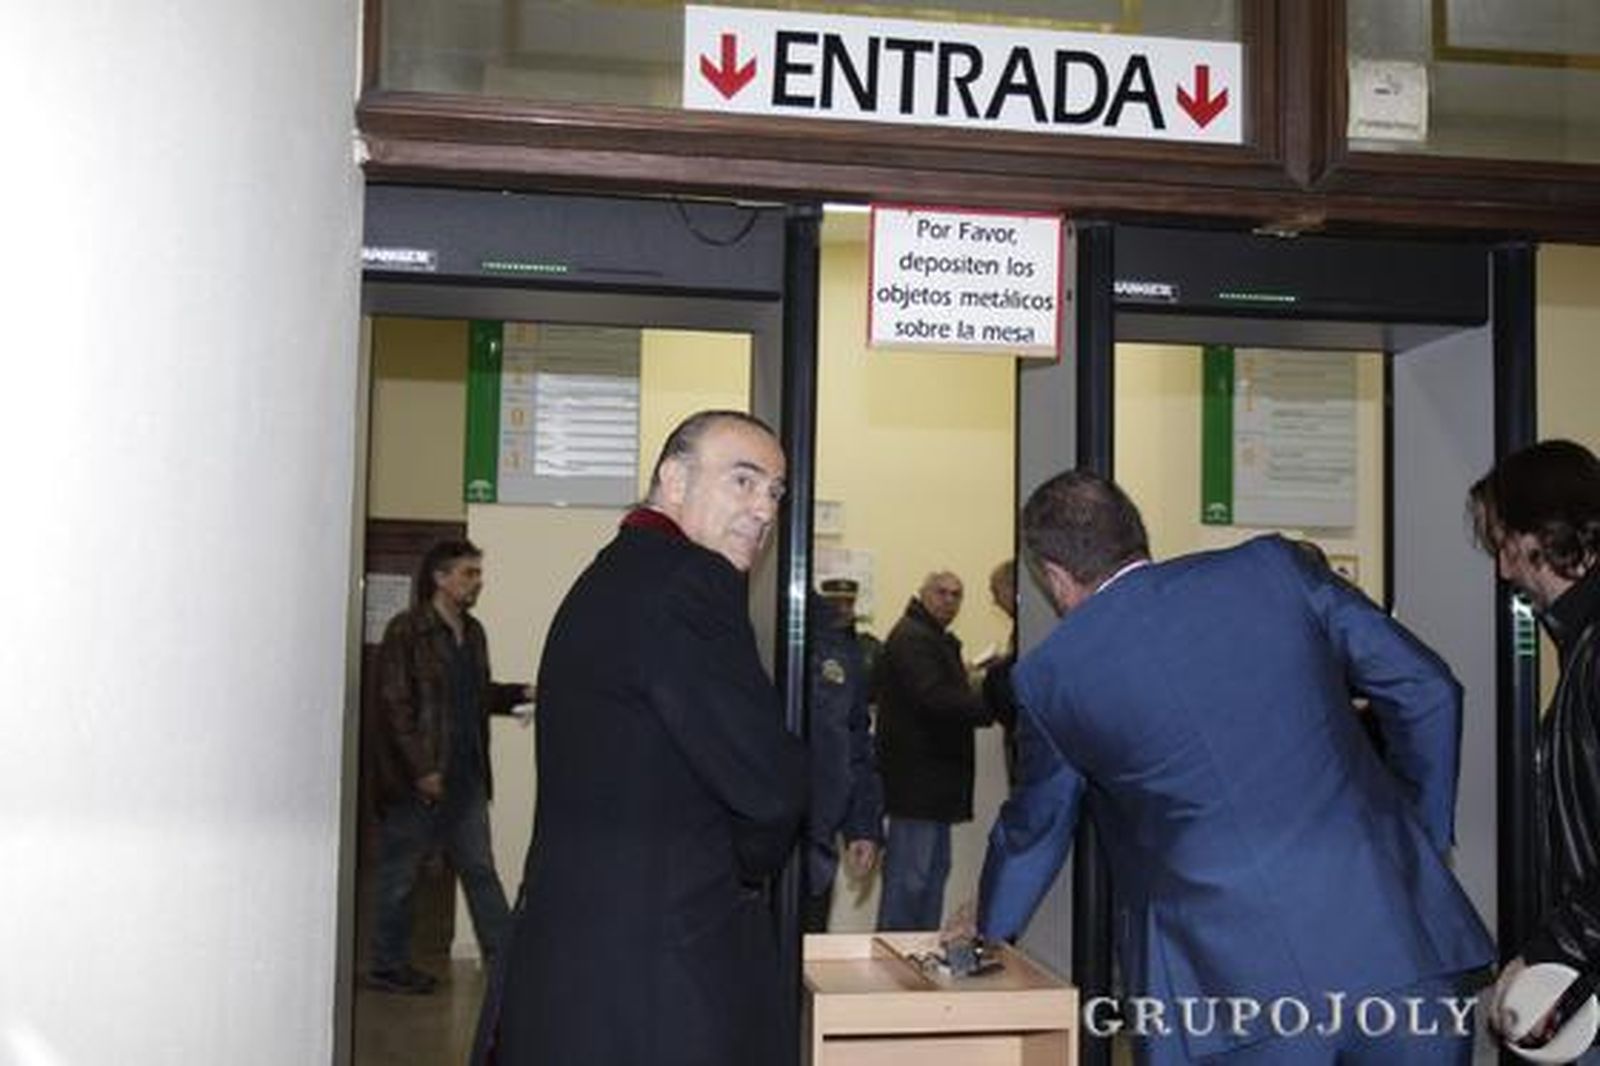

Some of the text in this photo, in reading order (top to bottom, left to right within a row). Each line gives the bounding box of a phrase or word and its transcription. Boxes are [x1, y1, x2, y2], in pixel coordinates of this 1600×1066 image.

[770, 30, 1166, 130] ENTRADA
[916, 219, 1018, 245] Por Favor,
[899, 251, 1035, 278] depositen los
[876, 284, 1054, 311] objetos metálicos
[895, 319, 1035, 343] sobre la mesa
